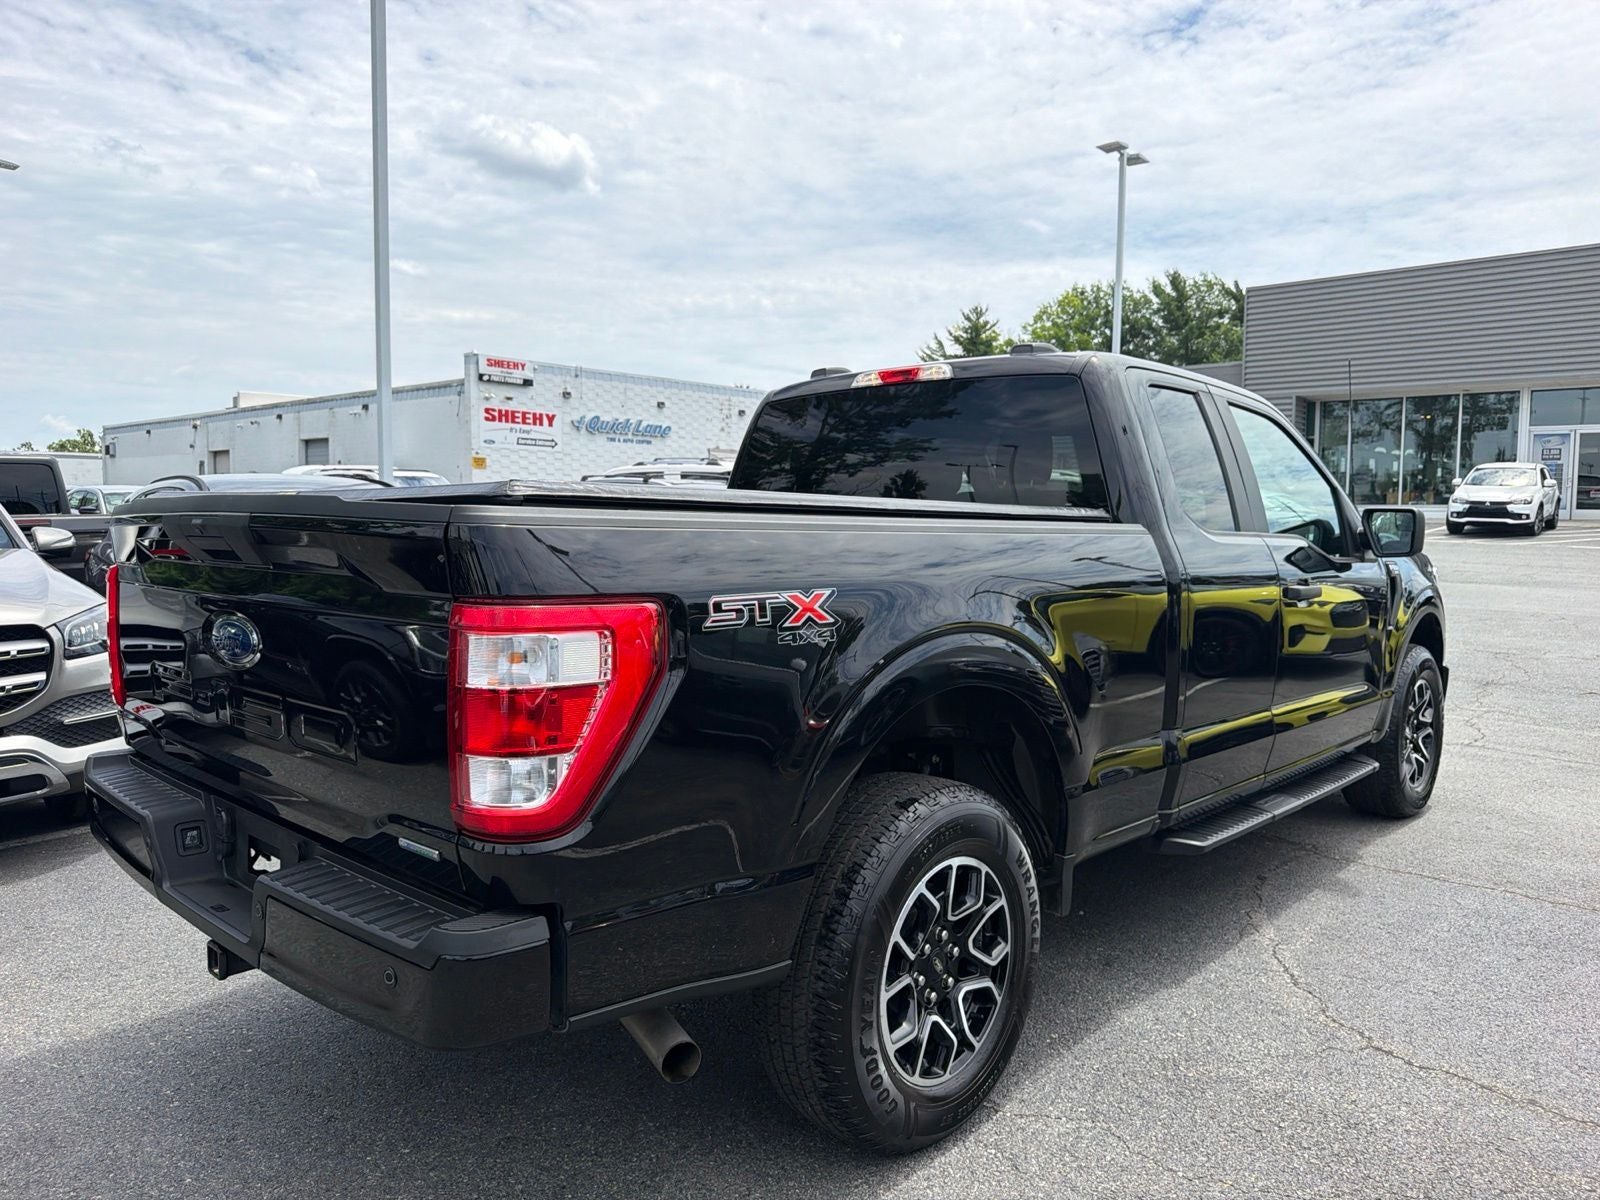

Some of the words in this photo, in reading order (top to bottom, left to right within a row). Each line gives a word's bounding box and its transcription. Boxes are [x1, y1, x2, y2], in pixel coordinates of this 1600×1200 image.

[486, 358, 526, 371] SHEEHY
[484, 407, 556, 427] SHEEHY
[586, 416, 632, 434] Quick
[632, 419, 672, 437] Lane
[702, 588, 841, 632] STX
